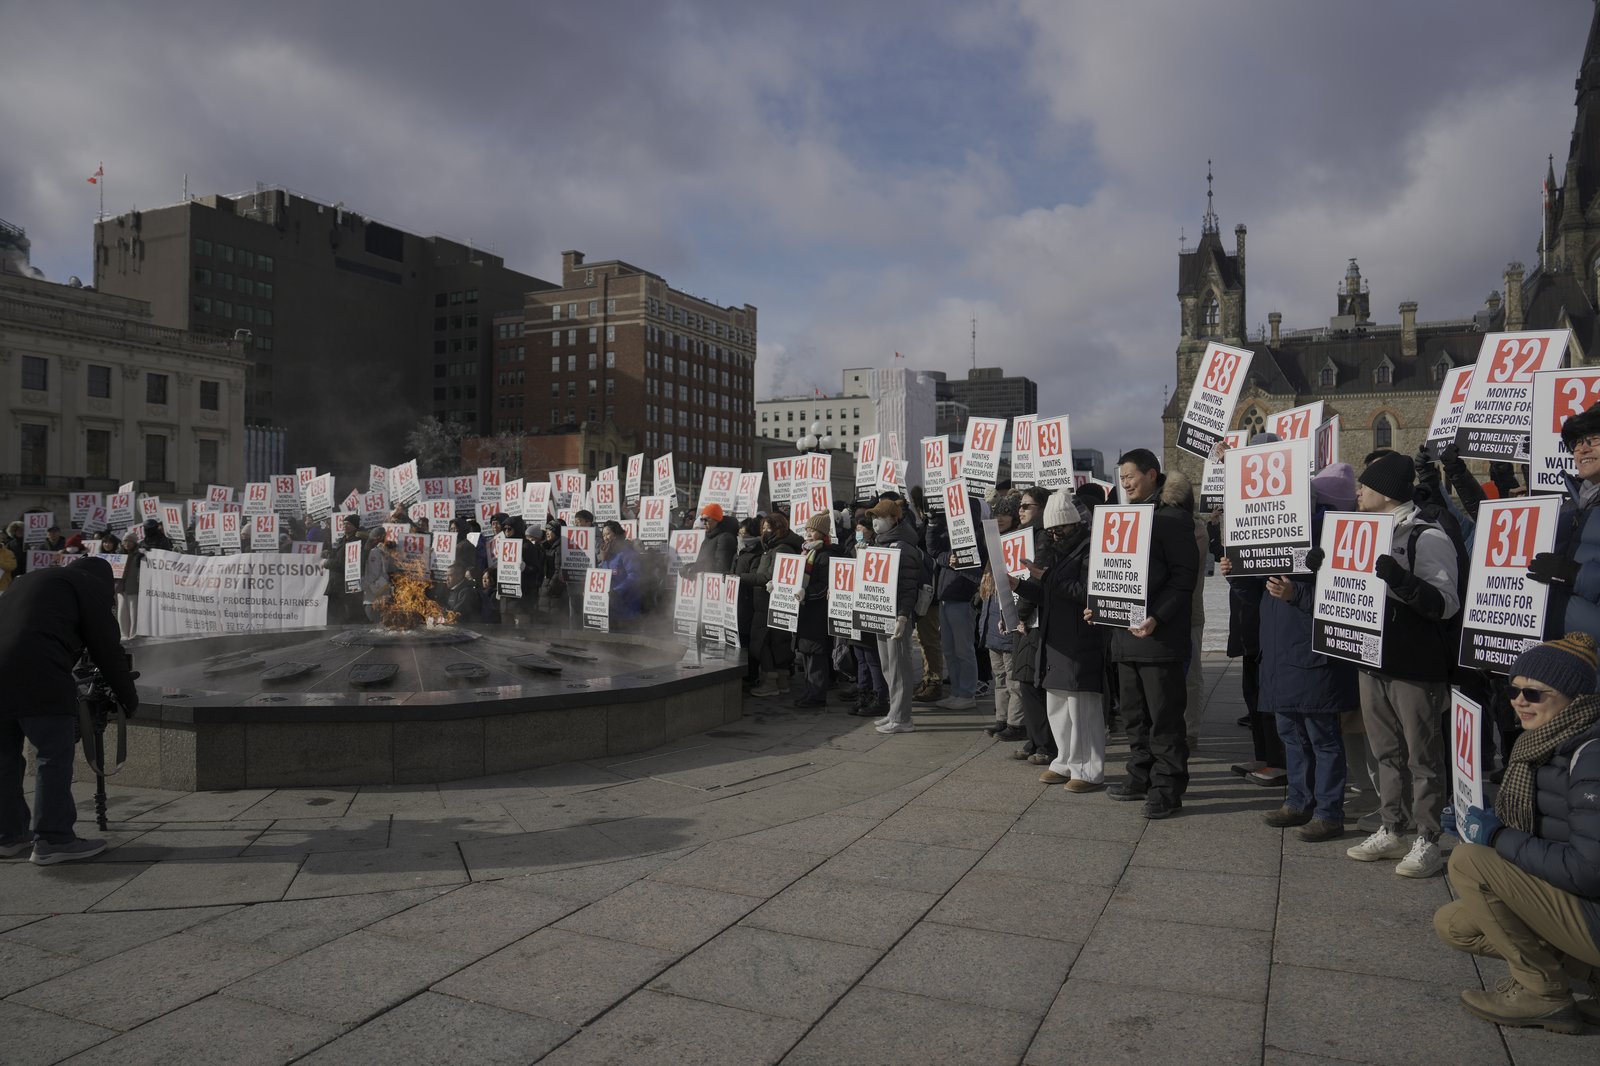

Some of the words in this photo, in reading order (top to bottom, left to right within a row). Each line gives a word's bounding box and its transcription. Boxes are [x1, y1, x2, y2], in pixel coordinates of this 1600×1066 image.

[1494, 338, 1541, 382] 32
[1207, 352, 1235, 392] 38
[1201, 392, 1223, 406] MONTHS
[1487, 388, 1527, 398] MONTHS
[1193, 401, 1214, 415] WAITING
[1213, 408, 1225, 419] FOR
[1474, 401, 1511, 411] WAITING
[1513, 401, 1531, 412] FOR
[1187, 411, 1199, 422] IRCC
[1198, 415, 1225, 432] RESPONSE
[1281, 411, 1307, 441] 37
[1465, 413, 1485, 424] IRCC
[1485, 414, 1531, 425] RESPONS
[973, 423, 994, 451] 37
[1017, 421, 1030, 450] 90
[1040, 423, 1060, 456] 39
[1186, 427, 1193, 435] NO
[1192, 429, 1215, 444] TIMELINES
[1433, 427, 1450, 436] IRCC
[1468, 432, 1478, 440] NO
[1479, 432, 1520, 443] TIMELINES
[863, 439, 874, 462] 70
[1185, 437, 1192, 445] NO
[1192, 439, 1211, 452] RESULTS
[1468, 442, 1479, 451] NO
[1479, 443, 1513, 454] RESULTS
[927, 442, 941, 468] 28
[971, 452, 989, 460] MONTHS
[1042, 459, 1061, 467] MONTHS
[1545, 457, 1577, 469] WAIT
[658, 458, 669, 479] 29
[795, 459, 807, 480] 27
[812, 457, 824, 479] 16
[966, 460, 983, 468] WAITING
[484, 470, 499, 485] 27
[711, 471, 730, 490] 63
[971, 469, 994, 478] RESPONSE
[1039, 469, 1055, 477] WAITING
[1245, 451, 1287, 498] 38
[1538, 472, 1565, 485] IRCC
[277, 477, 293, 493] 53
[425, 480, 443, 495] 39
[455, 479, 472, 494] 34
[568, 476, 580, 493] 38
[1049, 477, 1071, 486] RESPONSE
[212, 488, 227, 501] 42
[251, 485, 266, 500] 15
[506, 483, 518, 501] 33
[598, 484, 613, 503] 65
[813, 487, 827, 511] 31
[78, 495, 95, 508] 54
[113, 495, 128, 509] 42
[144, 500, 157, 514] 32
[366, 494, 384, 511] 55
[948, 485, 963, 516] 31
[1245, 500, 1286, 513] MONTHS
[434, 502, 449, 518] 34
[482, 502, 499, 520] 27
[647, 500, 664, 519] 72
[796, 502, 808, 525] 11
[31, 515, 47, 528] 30
[200, 514, 214, 529] 71
[224, 515, 235, 531] 53
[257, 516, 272, 532] 34
[1236, 515, 1275, 527] WAITING
[1278, 513, 1297, 524] FOR
[568, 530, 587, 549] 40
[1105, 512, 1136, 553] 37
[1230, 530, 1250, 541] IRCC
[1251, 526, 1304, 539] RESPONSE
[1491, 508, 1530, 566] 31
[437, 535, 451, 552] 33
[678, 534, 696, 553] 23
[1336, 520, 1372, 572] 40
[503, 542, 516, 562] 34
[1005, 537, 1022, 572] 37
[1239, 548, 1251, 558] NO
[1251, 546, 1294, 557] TIMELINES
[147, 558, 157, 569] WE
[158, 559, 205, 575] DEMA
[217, 563, 255, 575] TIMELY
[259, 563, 324, 576] DECISION
[865, 553, 888, 582] 37
[1104, 558, 1131, 568] MONTHS
[1243, 559, 1255, 569] NO
[1255, 557, 1291, 568] RESULTS
[780, 558, 796, 585] 14
[836, 563, 852, 591] 37
[1096, 570, 1123, 580] WAITING
[1125, 572, 1138, 581] FOR
[173, 575, 221, 588] DELAYED
[224, 577, 240, 590] BY
[243, 577, 274, 590] IRCC
[591, 572, 604, 592] 35
[707, 578, 719, 600] 36
[864, 584, 885, 594] MONTHS
[1092, 581, 1107, 591] IRCC
[1107, 583, 1142, 594] RESPONSE
[1333, 576, 1366, 590] MONTHS
[1486, 576, 1524, 590] MONTHS
[146, 589, 182, 600] REANABLE
[182, 594, 215, 603] TIMELINES
[223, 597, 277, 606] PROCEDURAL
[279, 598, 319, 607] FAIRNESS
[835, 593, 852, 602] MONTHS
[858, 593, 879, 602] WAITING
[1097, 599, 1105, 607] NO
[1325, 589, 1355, 604] WAITING
[1358, 595, 1373, 607] FOR
[1476, 592, 1511, 608] WAITING
[1513, 595, 1533, 610] FOR
[832, 601, 847, 609] WAITING
[866, 603, 893, 612] RESPONSE
[1318, 603, 1334, 616] IRCC
[1335, 606, 1377, 623] RESPONSE
[1099, 609, 1107, 618] NO
[1108, 610, 1132, 620] RESULTS
[1469, 608, 1487, 623] IRCC
[1487, 611, 1537, 629] RESPONSE
[1324, 625, 1334, 636] NO
[1334, 627, 1364, 642] TIMELINE
[1326, 637, 1335, 648] NO
[1336, 639, 1363, 654] RESULTS
[1473, 634, 1484, 645] NO
[1484, 635, 1523, 652] TIMELINES
[1475, 649, 1485, 660] NO
[1485, 650, 1517, 666] RESULTS
[1457, 707, 1472, 778] 22
